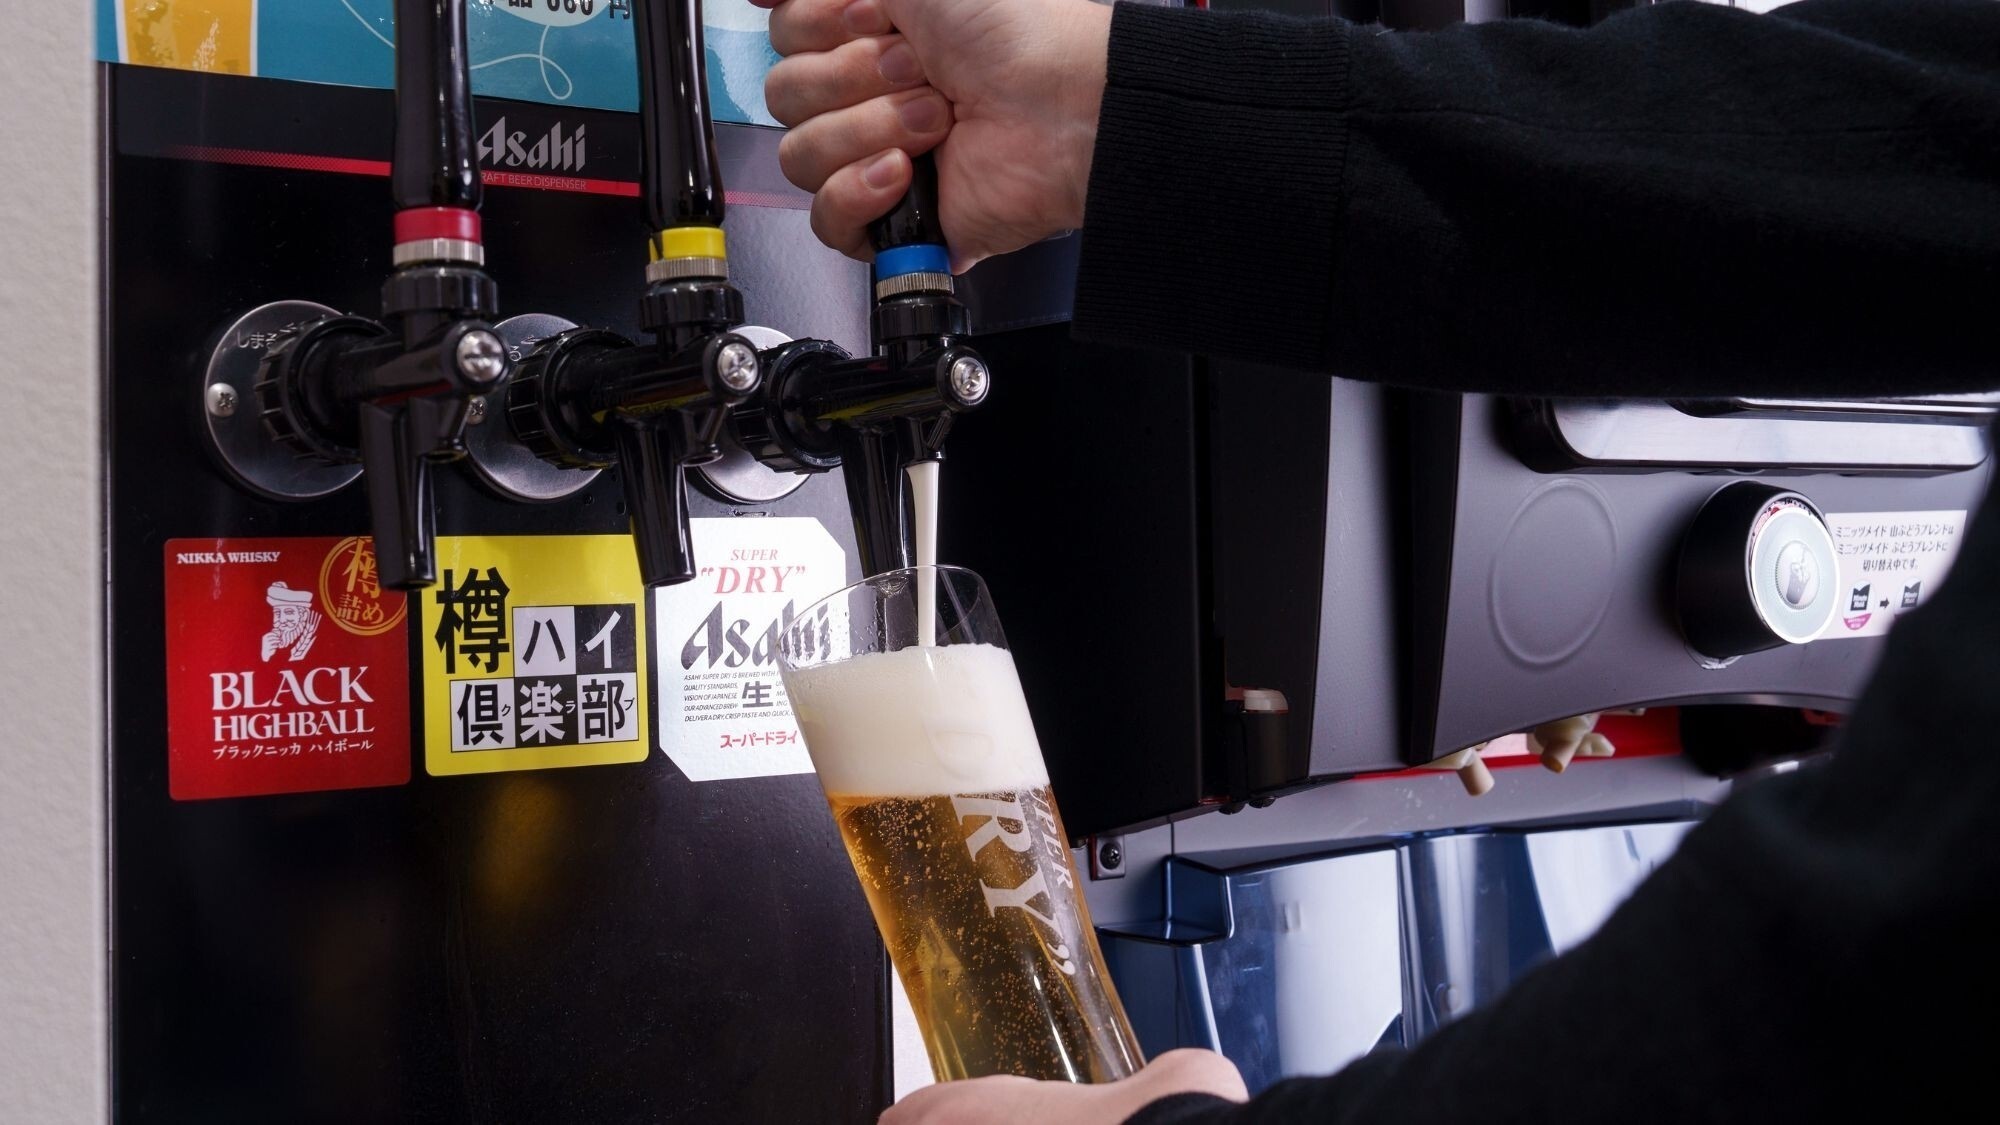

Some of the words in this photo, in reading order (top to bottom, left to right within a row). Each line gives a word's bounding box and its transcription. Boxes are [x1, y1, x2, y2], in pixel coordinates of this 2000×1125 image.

[477, 116, 586, 172] Asahi
[482, 171, 506, 184] RAFT
[508, 174, 533, 186] BEER
[534, 175, 587, 190] DISPENSER
[176, 552, 226, 565] NIKKA
[228, 551, 282, 564] WHISKY
[730, 549, 778, 561] SUPER
[680, 598, 831, 670] Asahi
[209, 666, 374, 710] BLACK
[684, 683, 707, 691] QUALITY
[742, 681, 773, 708] 生
[213, 708, 375, 742] HIGHBALL
[213, 742, 301, 760] ブラックニッカ
[309, 738, 374, 755] ハイボール
[720, 730, 799, 749] スーパードライ
